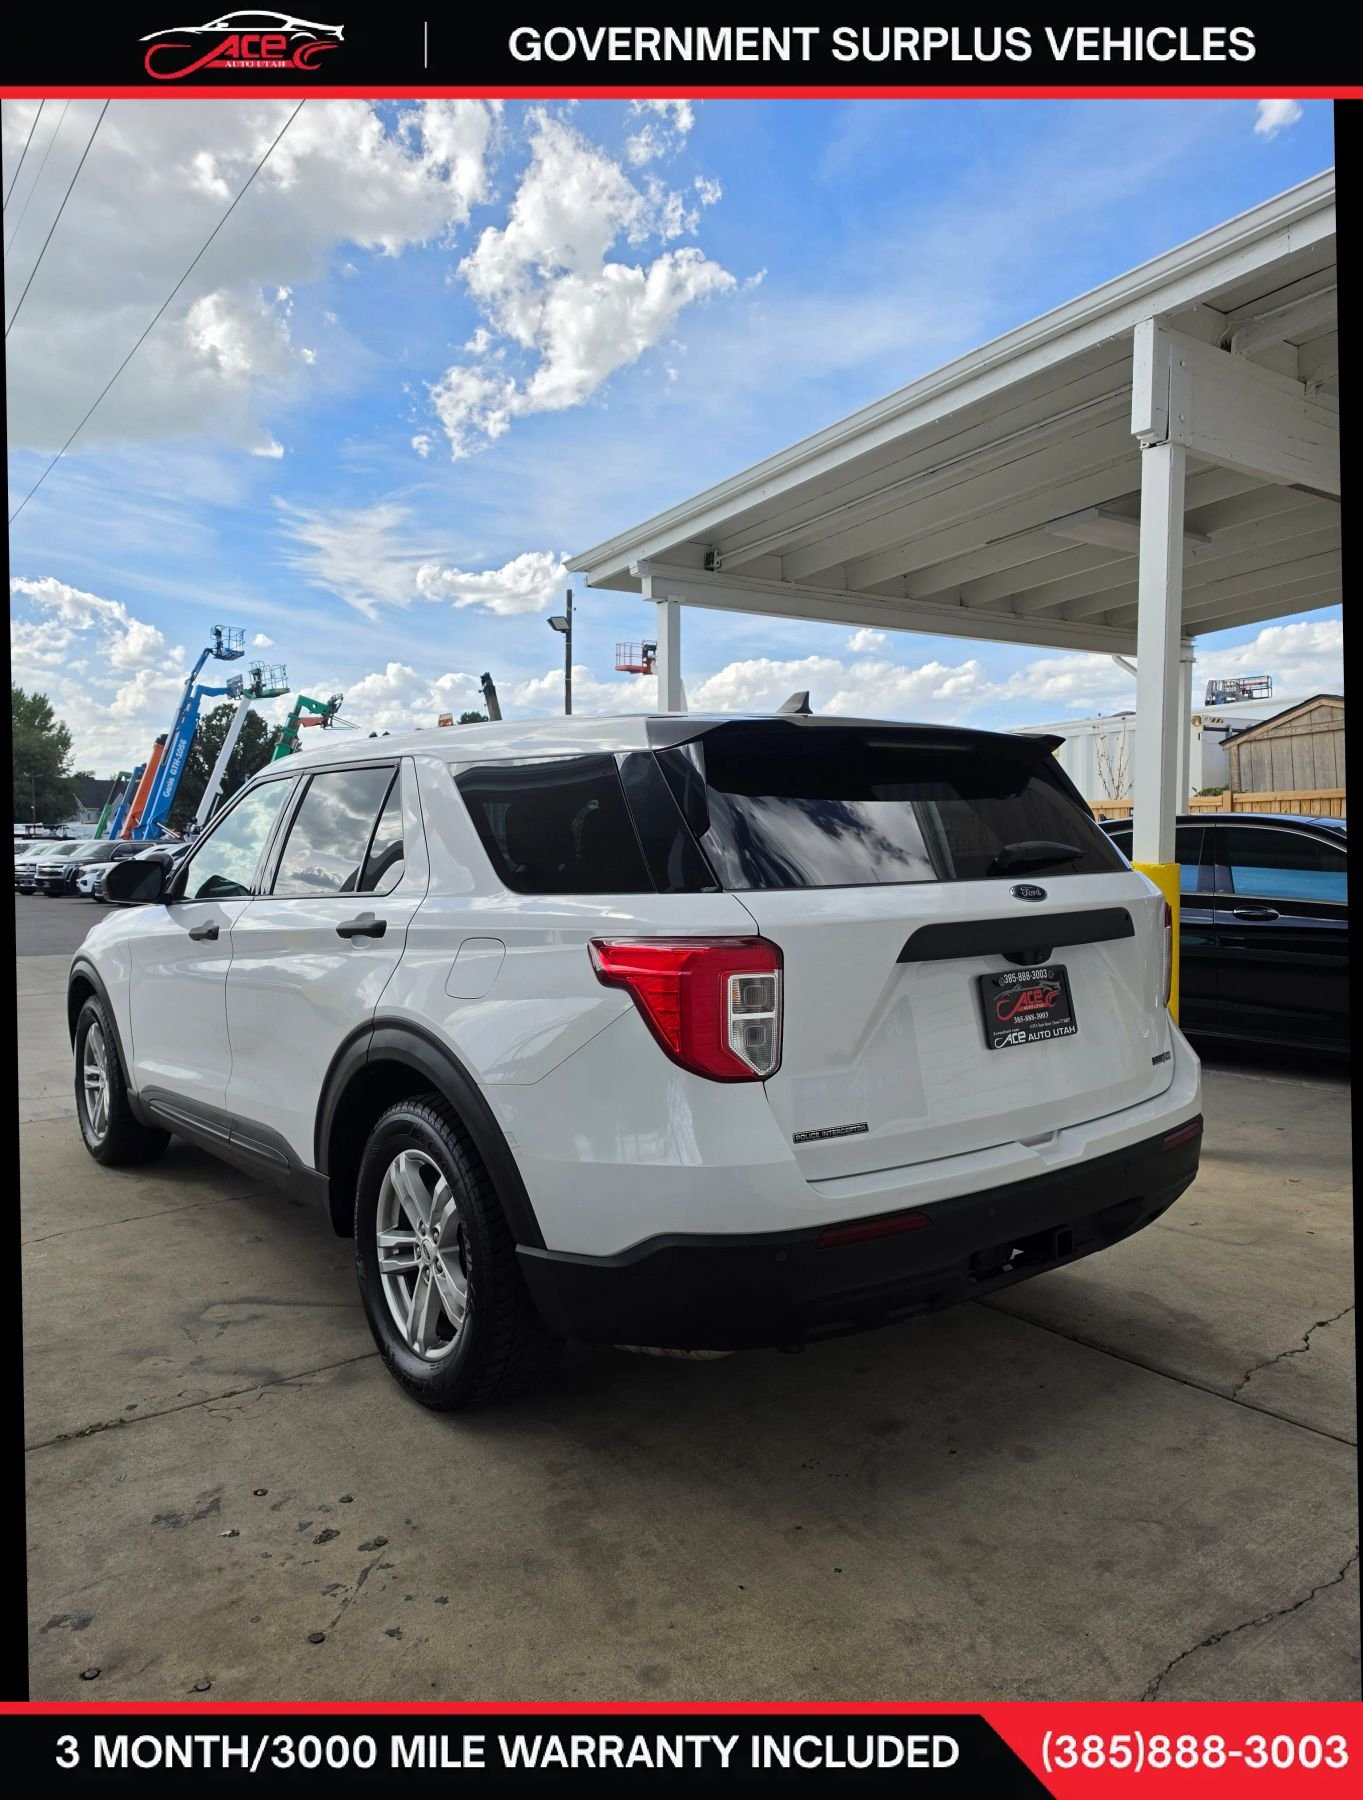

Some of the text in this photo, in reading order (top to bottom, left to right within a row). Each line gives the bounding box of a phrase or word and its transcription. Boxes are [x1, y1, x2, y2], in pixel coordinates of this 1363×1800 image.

[1020, 887, 1041, 896] Ford
[1003, 969, 1048, 983] 385-888-3003
[1014, 1012, 1049, 1023] 385-888-3003
[1028, 1030, 1050, 1040] AUTO
[1053, 1026, 1075, 1036] UTAH
[795, 1132, 819, 1140] POLICE
